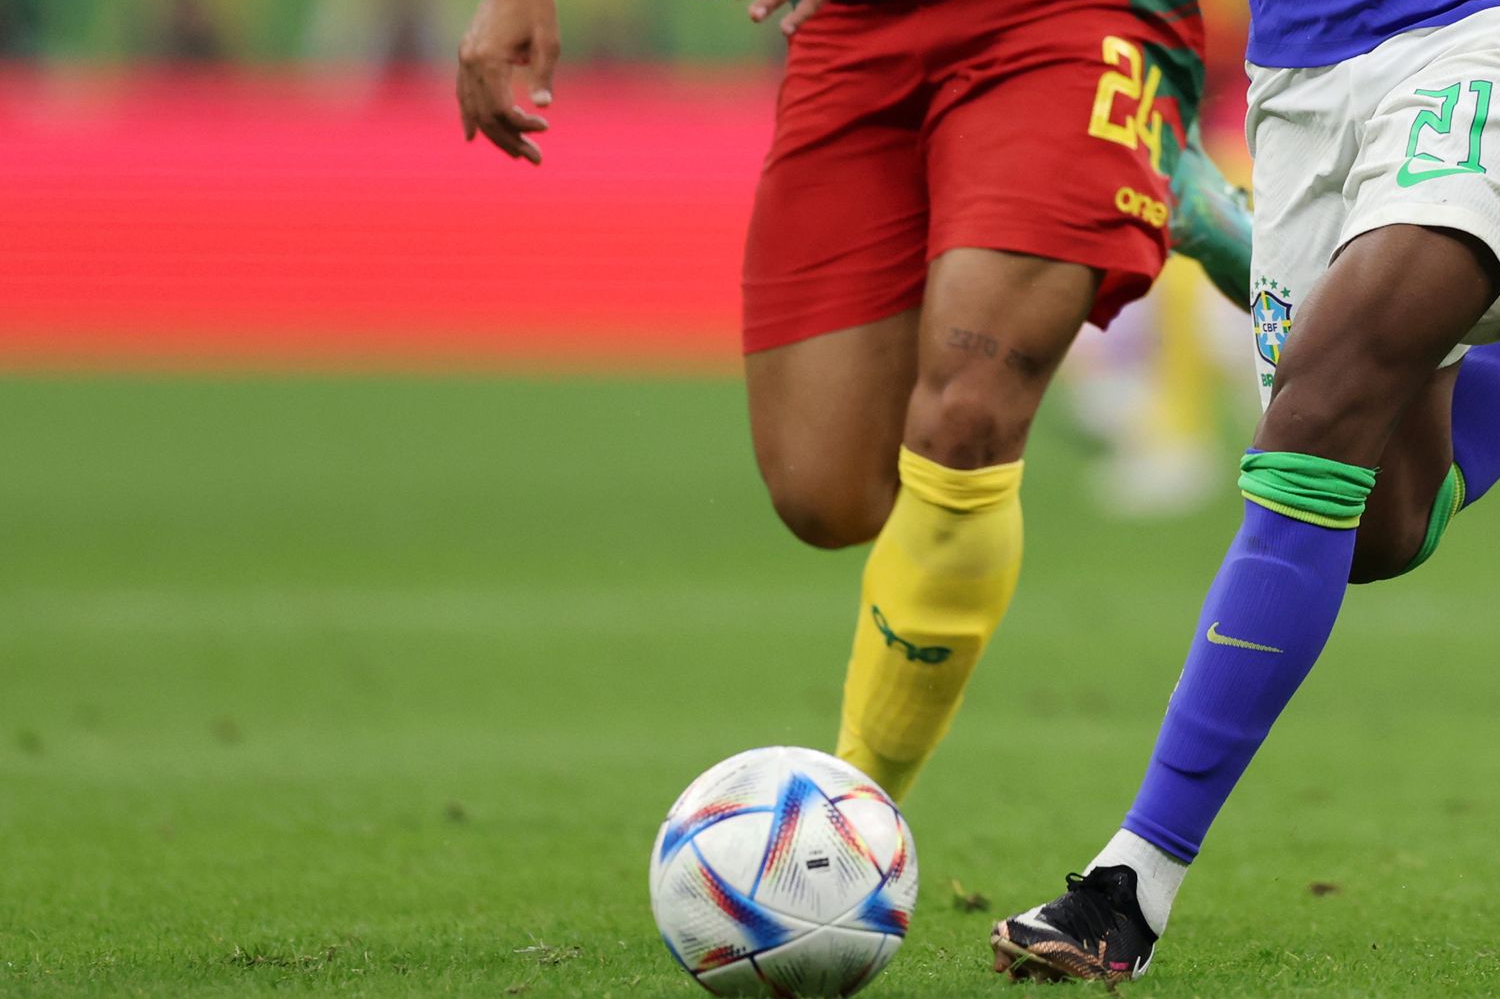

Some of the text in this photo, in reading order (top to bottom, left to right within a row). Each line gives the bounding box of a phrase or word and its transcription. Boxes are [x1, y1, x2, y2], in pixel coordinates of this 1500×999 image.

[1088, 35, 1162, 173] 24
[1405, 80, 1493, 174] 21
[1115, 186, 1169, 228] one
[1262, 322, 1278, 333] CBF
